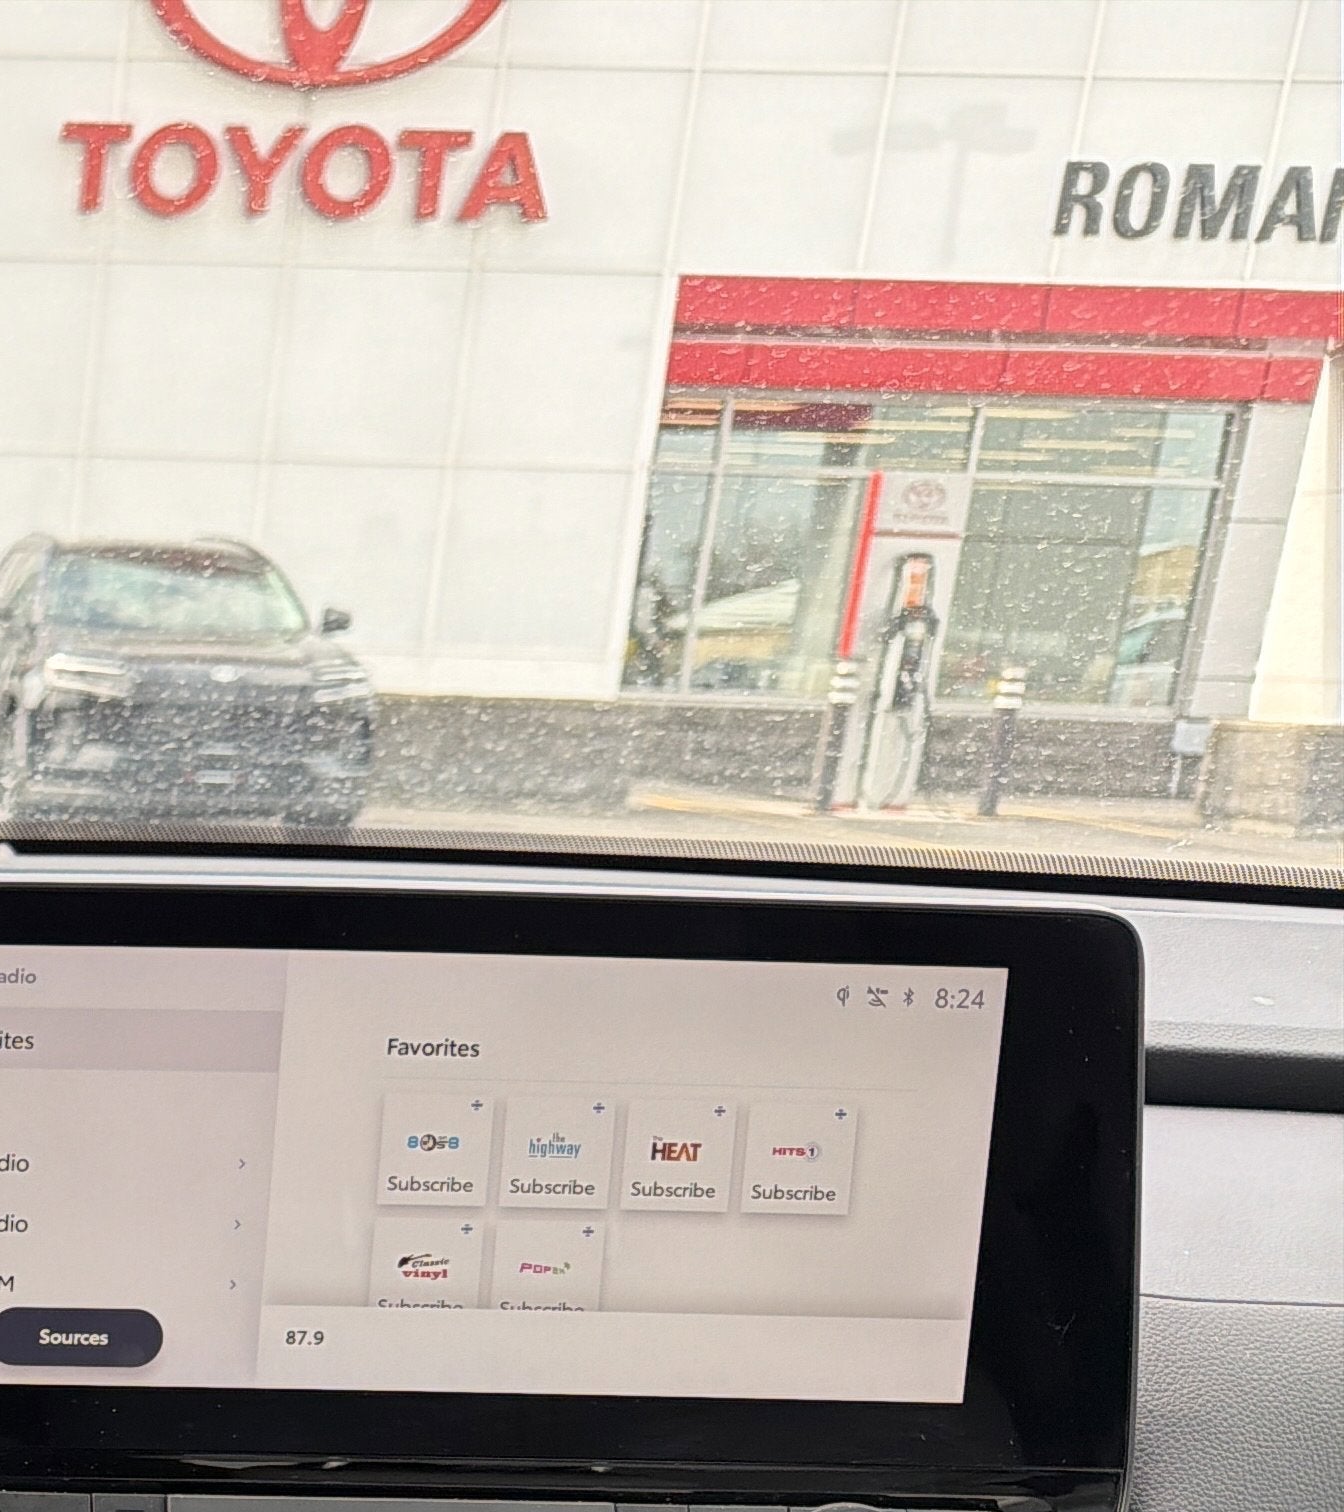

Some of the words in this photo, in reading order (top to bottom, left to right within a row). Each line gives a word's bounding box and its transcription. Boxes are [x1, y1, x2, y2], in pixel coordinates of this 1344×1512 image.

[60, 122, 548, 223] TOYOTA
[934, 987, 986, 1010] 8:24
[386, 1037, 481, 1058] Favorites
[528, 1138, 582, 1158] highway
[650, 1142, 702, 1162] HEAT
[386, 1175, 474, 1193] Subscribe
[509, 1178, 596, 1196] Subscribe
[630, 1181, 716, 1198] Subscribe
[751, 1184, 837, 1201] Subscribe
[401, 1268, 448, 1280] vinyl
[38, 1328, 109, 1347] Sources
[285, 1330, 325, 1346] 87.9
